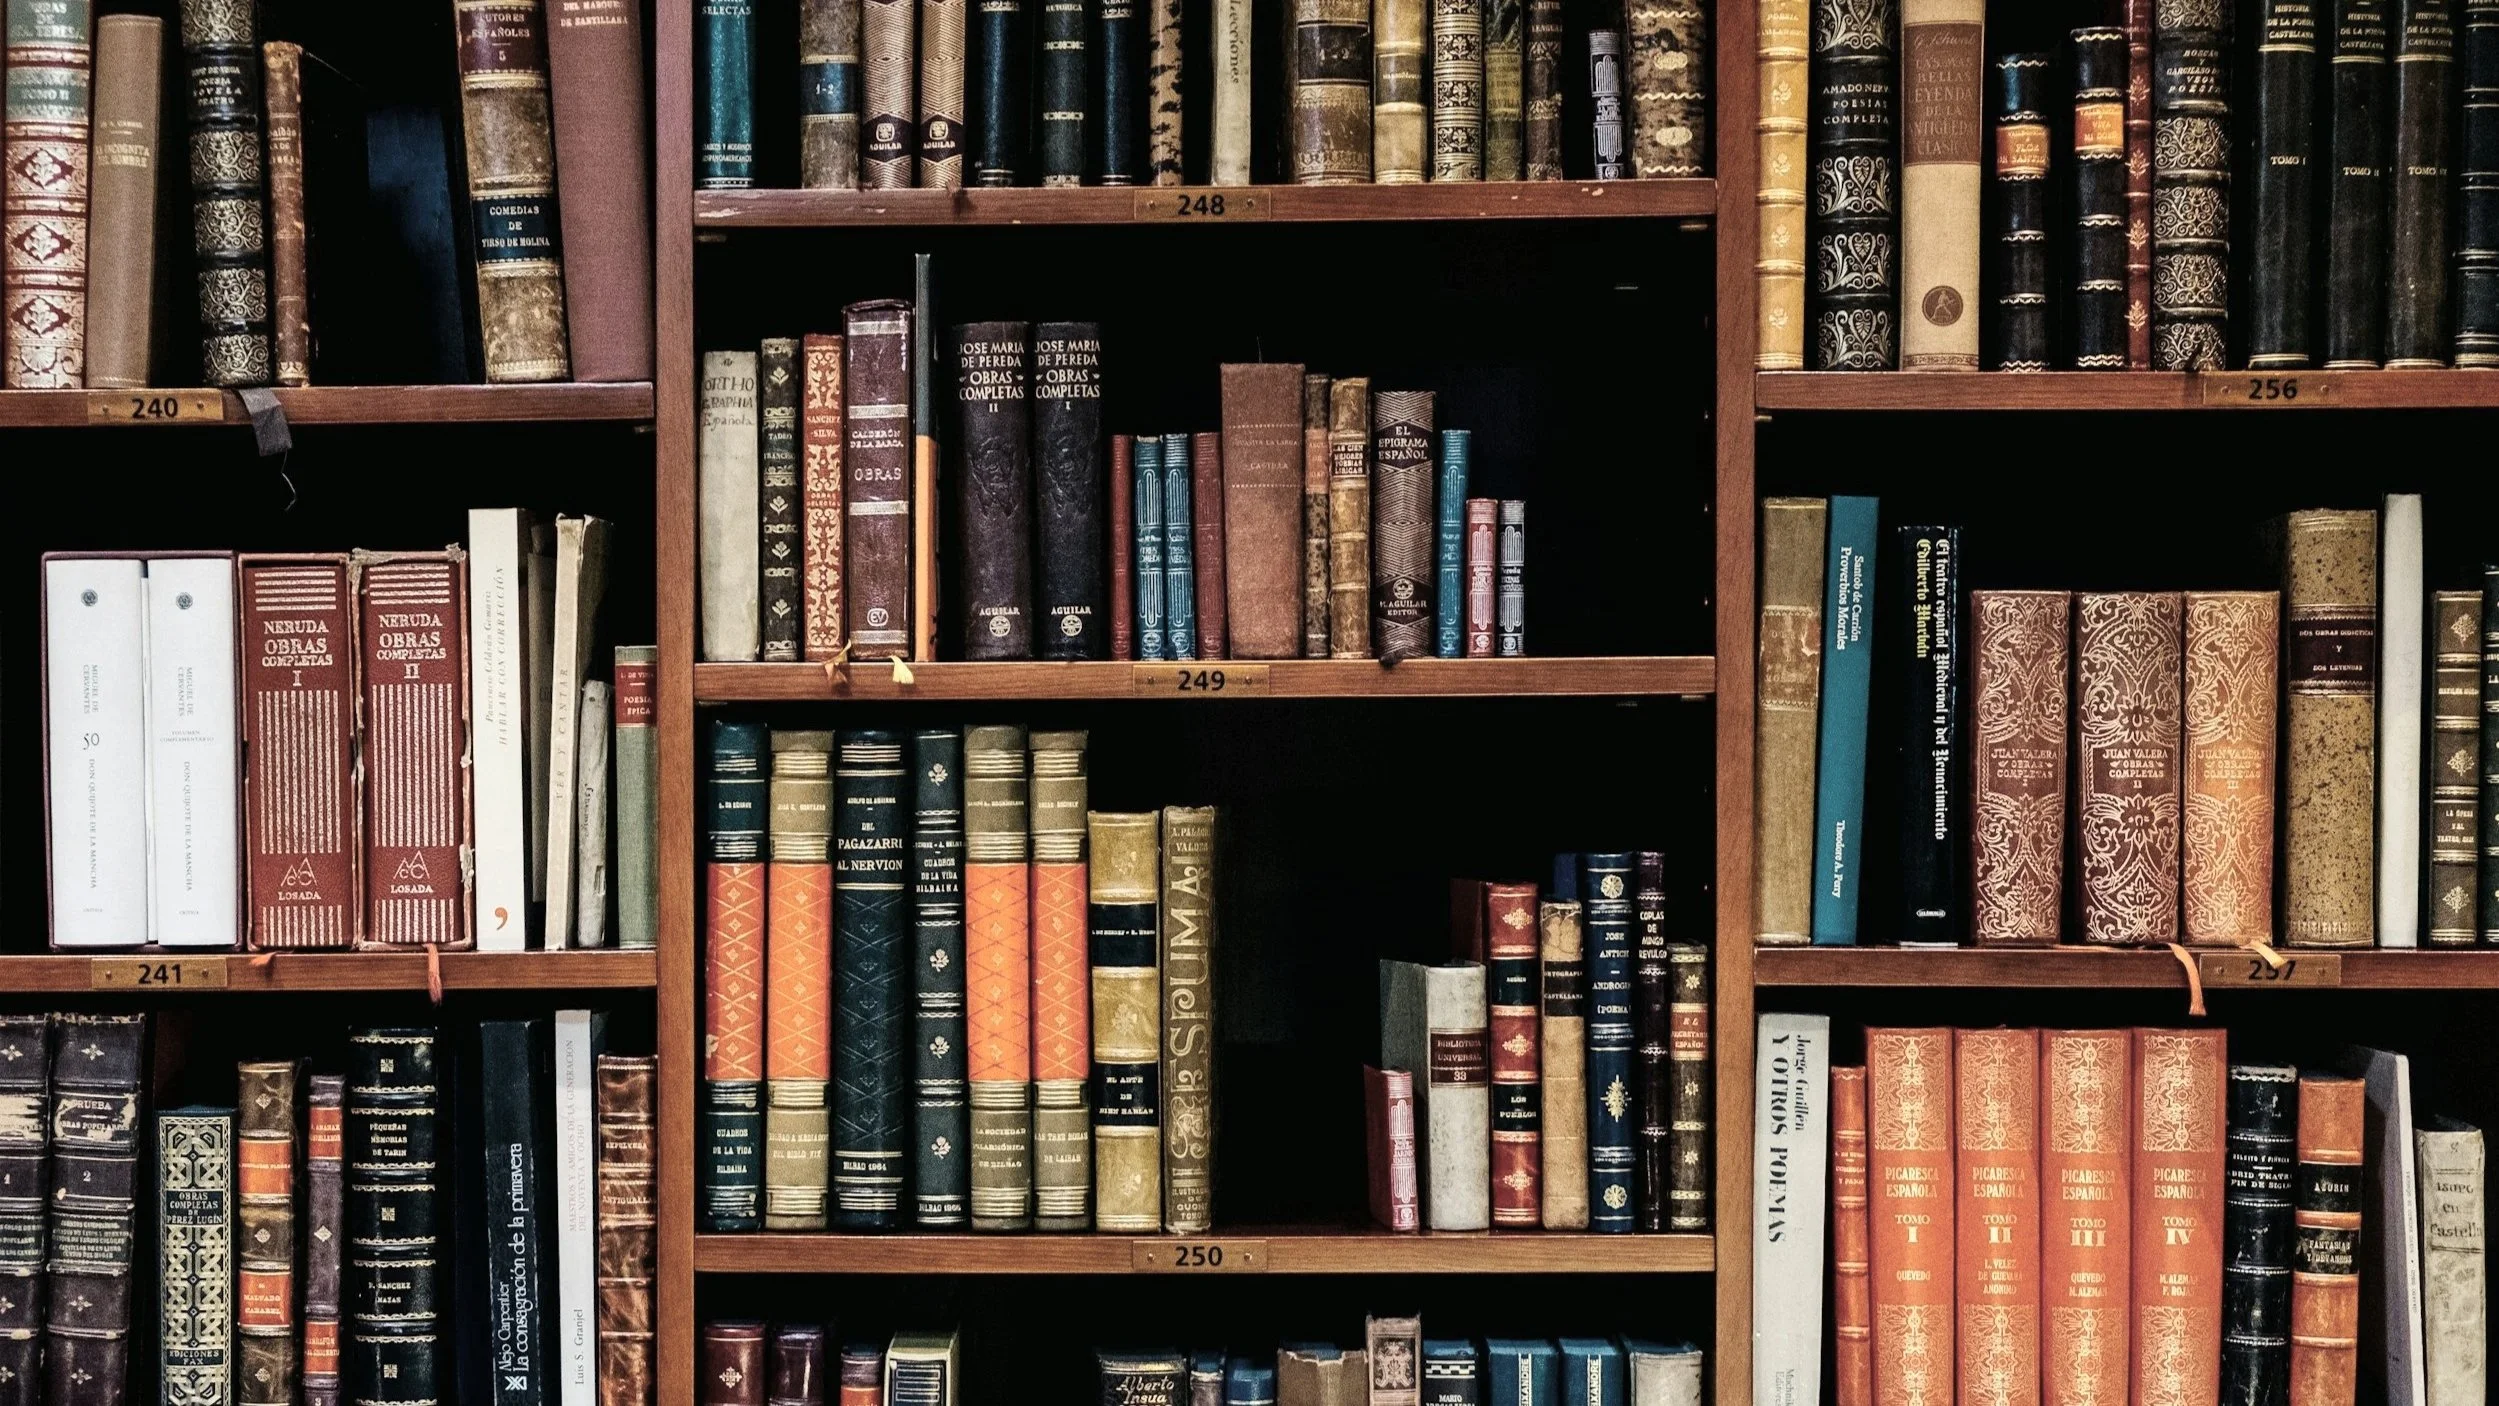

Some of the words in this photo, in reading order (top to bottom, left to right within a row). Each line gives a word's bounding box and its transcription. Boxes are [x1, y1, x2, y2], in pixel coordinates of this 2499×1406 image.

[702, 6, 751, 15] SELECTAS
[2275, 5, 2309, 13] HISTORIA
[2348, 13, 2380, 21] HISTORIA
[473, 28, 530, 38] ESPAÑOLES
[2340, 41, 2384, 49] CASTELLANA
[499, 51, 506, 62] 5
[869, 142, 901, 152] AGUILAR
[923, 140, 956, 150] AGUILAR
[2271, 157, 2299, 165] TOMO
[2408, 167, 2436, 175] TOMO
[489, 205, 539, 216] COMEDIAS
[1178, 195, 1224, 215] 248
[508, 222, 522, 230] DE
[482, 239, 505, 247] TIRSO
[507, 238, 518, 246] DE
[520, 237, 549, 246] MOLINA
[958, 342, 988, 355] JOSE
[991, 342, 1024, 353] MARIA
[1035, 341, 1063, 353] JOSE
[1067, 340, 1100, 351] MARIA
[962, 356, 974, 368] DE
[979, 355, 1021, 367] PEREDA
[1038, 355, 1051, 366] DE
[1055, 355, 1098, 366] PEREDA
[970, 371, 1012, 385] OBRAS
[1046, 369, 1088, 383] OBRAS
[959, 386, 1024, 400] COMPLETAS
[1036, 385, 1100, 398] COMPLETAS
[2249, 379, 2297, 399] 256
[132, 398, 178, 418] 240
[989, 403, 998, 412] II
[1066, 401, 1070, 410] I
[852, 429, 900, 438] CALDERÓN
[1396, 426, 1410, 435] EL
[1379, 438, 1428, 448] EPIGRAMA
[1379, 449, 1427, 460] ESPAÑOL
[855, 468, 901, 481] OBRAS
[1838, 546, 1852, 606] Proverbios
[1853, 556, 1864, 590] Santob
[1853, 593, 1863, 604] de
[979, 607, 1020, 616] AGUILAR
[1051, 606, 1091, 614] AGUILAR
[379, 614, 442, 627] NERUDA
[1850, 607, 1862, 642] Carrión
[264, 621, 329, 634] NERUDA
[1836, 608, 1850, 650] Morales
[379, 632, 440, 648] OBRAS
[265, 639, 327, 654] OBRAS
[376, 649, 446, 660] COMPLETAS
[262, 655, 333, 667] COMPLETAS
[404, 664, 420, 679] II
[292, 670, 301, 686] I
[1177, 671, 1225, 691] 249
[83, 733, 100, 750] 50
[1991, 749, 2019, 758] JUAN
[2022, 749, 2057, 758] VALERA
[2102, 749, 2131, 759] JUAN
[2134, 749, 2168, 758] VALERA
[2197, 749, 2225, 759] JUAN
[2227, 749, 2262, 759] VALERA
[2011, 760, 2043, 769] OBRAS
[2123, 760, 2154, 768] OBRAS
[2218, 760, 2250, 769] OBRAS
[1997, 769, 2053, 778] COMPLETAS
[2109, 769, 2164, 778] COMPLETAS
[2203, 769, 2261, 778] COMPLETAS
[838, 838, 903, 850] PAGAZARRI
[1836, 820, 1845, 861] Theodore
[837, 861, 848, 870] AL
[851, 860, 903, 870] NERVION
[1834, 862, 1844, 872] A.
[921, 872, 930, 880] DE
[931, 872, 940, 880] LA
[942, 872, 957, 880] VIDA
[391, 885, 433, 894] LOSADA
[916, 884, 958, 893] BILBAINA
[1832, 874, 1843, 898] Perry
[278, 891, 321, 900] LOSADA
[1640, 911, 1664, 920] COPLAS
[1648, 924, 1657, 933] DE
[1641, 937, 1664, 946] MINGO
[1639, 949, 1667, 959] REVULGO
[138, 964, 181, 983] 241
[2249, 960, 2296, 980] 257
[1773, 1035, 1790, 1044] Y
[1438, 1053, 1481, 1061] UNIVERSAL
[1794, 1035, 1811, 1074] Jorge
[1454, 1072, 1466, 1080] 33
[1770, 1057, 1790, 1135] OTROS
[1794, 1079, 1809, 1131] Guillén
[370, 1123, 407, 1131] PEQUEÑAS
[717, 1129, 748, 1137] CUADROS
[83, 1171, 91, 1182] 2
[507, 1144, 529, 1212] primavera
[1886, 1167, 1939, 1181] PICARESCA
[1973, 1167, 2025, 1180] PICARESCA
[2062, 1168, 2115, 1183] PICARESCA
[2153, 1168, 2207, 1182] PICARESCA
[1768, 1148, 1788, 1243] POEMAS
[1886, 1183, 1938, 1198] ESPAÑOLA
[1974, 1183, 2024, 1198] ESPAÑOLA
[2063, 1186, 2113, 1200] ESPAÑOLA
[2154, 1185, 2205, 1199] ESPAÑOLA
[179, 1193, 208, 1201] OBRAS
[170, 1201, 218, 1210] COMPLETAS
[507, 1215, 525, 1227] la
[1895, 1214, 1930, 1224] TOMO
[1982, 1214, 2017, 1224] TOMO
[2070, 1218, 2106, 1228] TOMO
[2162, 1217, 2197, 1226] TOMO
[1907, 1226, 1918, 1243] I
[1989, 1226, 2012, 1243] II
[2071, 1230, 2106, 1246] III
[2166, 1228, 2195, 1245] IV
[507, 1230, 526, 1255] de
[2309, 1240, 2350, 1249] FANTASIAS
[1175, 1246, 1223, 1266] 250
[1897, 1270, 1930, 1281] QUEVEDO
[2071, 1273, 2105, 1283] QUEVEDO
[497, 1282, 513, 1339] Carpentier
[510, 1259, 533, 1354] consagración
[574, 1309, 584, 1344] Granjel
[169, 1350, 219, 1358] EDICIONES
[498, 1344, 514, 1369] Alejo
[576, 1348, 584, 1360] S.
[514, 1357, 529, 1372] La
[576, 1366, 584, 1385] Luis
[1116, 1376, 1175, 1392] Alberto
[1123, 1390, 1168, 1404] Insua
